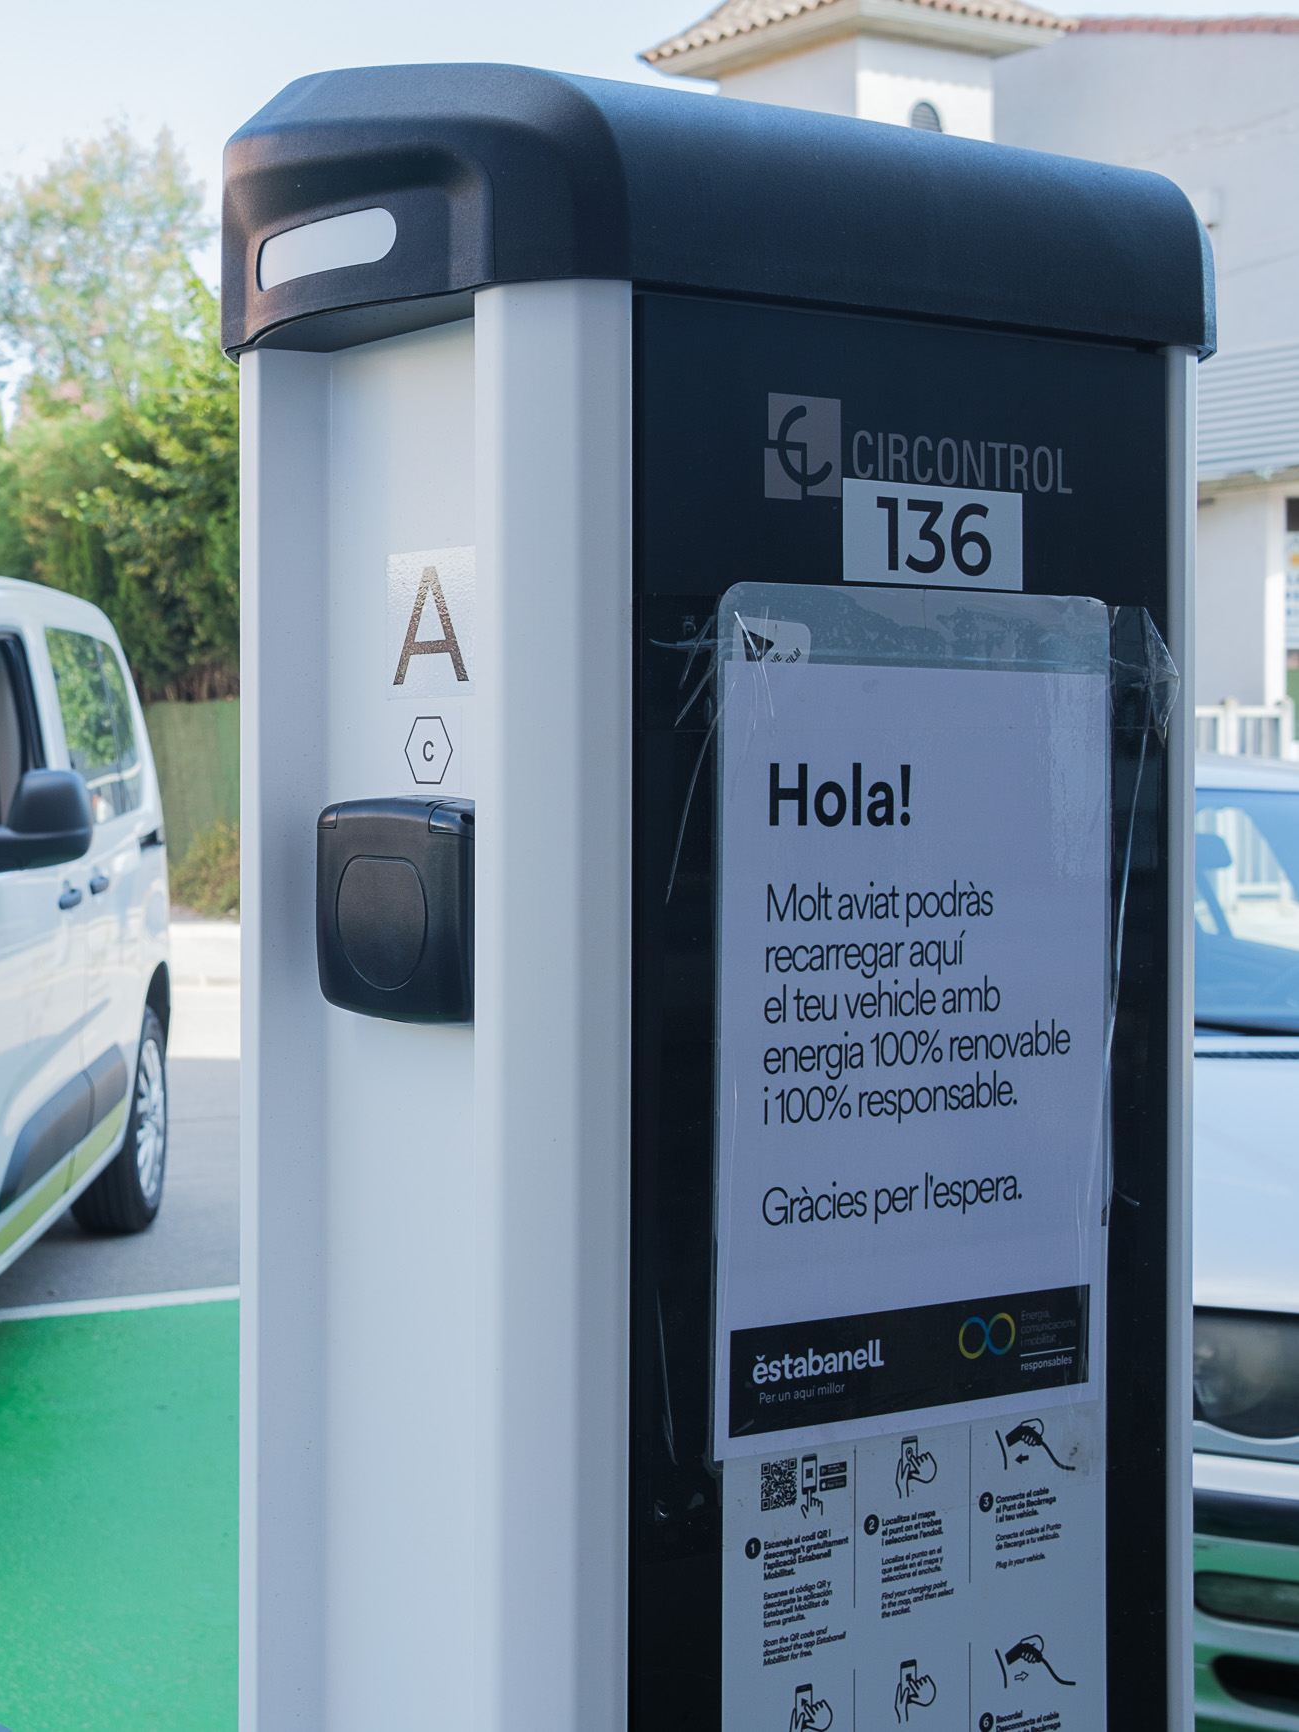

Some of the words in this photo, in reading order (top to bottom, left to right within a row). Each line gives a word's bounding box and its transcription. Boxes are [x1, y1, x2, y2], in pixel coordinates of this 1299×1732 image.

[852, 430, 1073, 494] CIRCONTROL
[876, 495, 993, 577] 136
[393, 566, 470, 685] A
[422, 740, 435, 762] C
[769, 762, 911, 827] Hola!
[766, 881, 832, 923] Molt
[838, 881, 900, 921] aviat
[906, 879, 994, 928] podràs
[765, 941, 905, 979] recarregar
[909, 930, 966, 975] aquí
[764, 983, 787, 1024] el
[793, 988, 837, 1022] teu
[844, 978, 937, 1020] vehicle
[942, 975, 1001, 1015] amb
[763, 1031, 864, 1081] energia
[870, 1029, 944, 1067] 100%
[950, 1018, 1071, 1063] renovable
[763, 1086, 769, 1125] i
[775, 1084, 852, 1124] 100%
[858, 1070, 1018, 1124] responsable.
[762, 1181, 868, 1226] Gràcies
[874, 1184, 919, 1225] per
[924, 1171, 1023, 1215] l'espera.
[1021, 1310, 1051, 1322] Energia,
[1021, 1319, 1076, 1334] comunicacions
[1021, 1355, 1072, 1371] responsables
[759, 1392, 776, 1404] Per
[778, 1391, 790, 1402] un
[793, 1385, 815, 1400] aquí
[817, 1381, 845, 1396] millor
[983, 1496, 989, 1507] 3
[996, 1493, 1025, 1503] Connecta
[1033, 1487, 1049, 1497] cable
[1003, 1503, 1016, 1512] Punt
[1017, 1501, 1025, 1509] de
[868, 1520, 875, 1530] 2
[882, 1515, 910, 1526] Localitza
[918, 1511, 935, 1519] mapa
[889, 1525, 903, 1536] punt
[922, 1519, 941, 1528] trobes
[996, 1532, 1018, 1541] Conecta
[1025, 1527, 1039, 1536] cable
[764, 1538, 793, 1550] Escaneja
[801, 1532, 815, 1542] codi
[817, 1530, 827, 1539] QR
[885, 1534, 918, 1545] selecciona
[996, 1543, 1003, 1551] de
[1004, 1540, 1025, 1548] Recarga
[750, 1542, 755, 1554] 1
[798, 1549, 831, 1563] Estabanell
[882, 1555, 904, 1565] Localiza
[912, 1551, 928, 1560] punto
[996, 1561, 1007, 1569] Plug
[1013, 1558, 1026, 1566] your
[882, 1567, 892, 1575] que
[882, 1572, 911, 1583] selecciona
[764, 1590, 787, 1600] Escanea
[817, 1580, 826, 1589] QR
[881, 1591, 893, 1600] Find
[894, 1590, 907, 1599] your
[908, 1584, 932, 1595] charging
[933, 1581, 947, 1590] point
[913, 1594, 924, 1603] and
[925, 1592, 937, 1600] then
[938, 1588, 954, 1597] select
[764, 1606, 793, 1619] Estabanell
[795, 1601, 820, 1611] Mobilitat
[821, 1598, 829, 1606] de
[763, 1619, 781, 1628] forma
[763, 1639, 778, 1648] Scan
[779, 1636, 788, 1644] the
[790, 1633, 799, 1642] QR
[800, 1630, 815, 1639] code
[816, 1626, 827, 1636] and
[763, 1644, 792, 1657] download
[793, 1642, 802, 1650] the
[804, 1640, 815, 1649] app
[816, 1631, 846, 1645] Estabanell
[763, 1654, 789, 1666] Mobilitat
[791, 1652, 799, 1660] for
[983, 1717, 989, 1728] 6
[996, 1719, 1035, 1732] Desconnecta
[1043, 1712, 1059, 1721] cable
